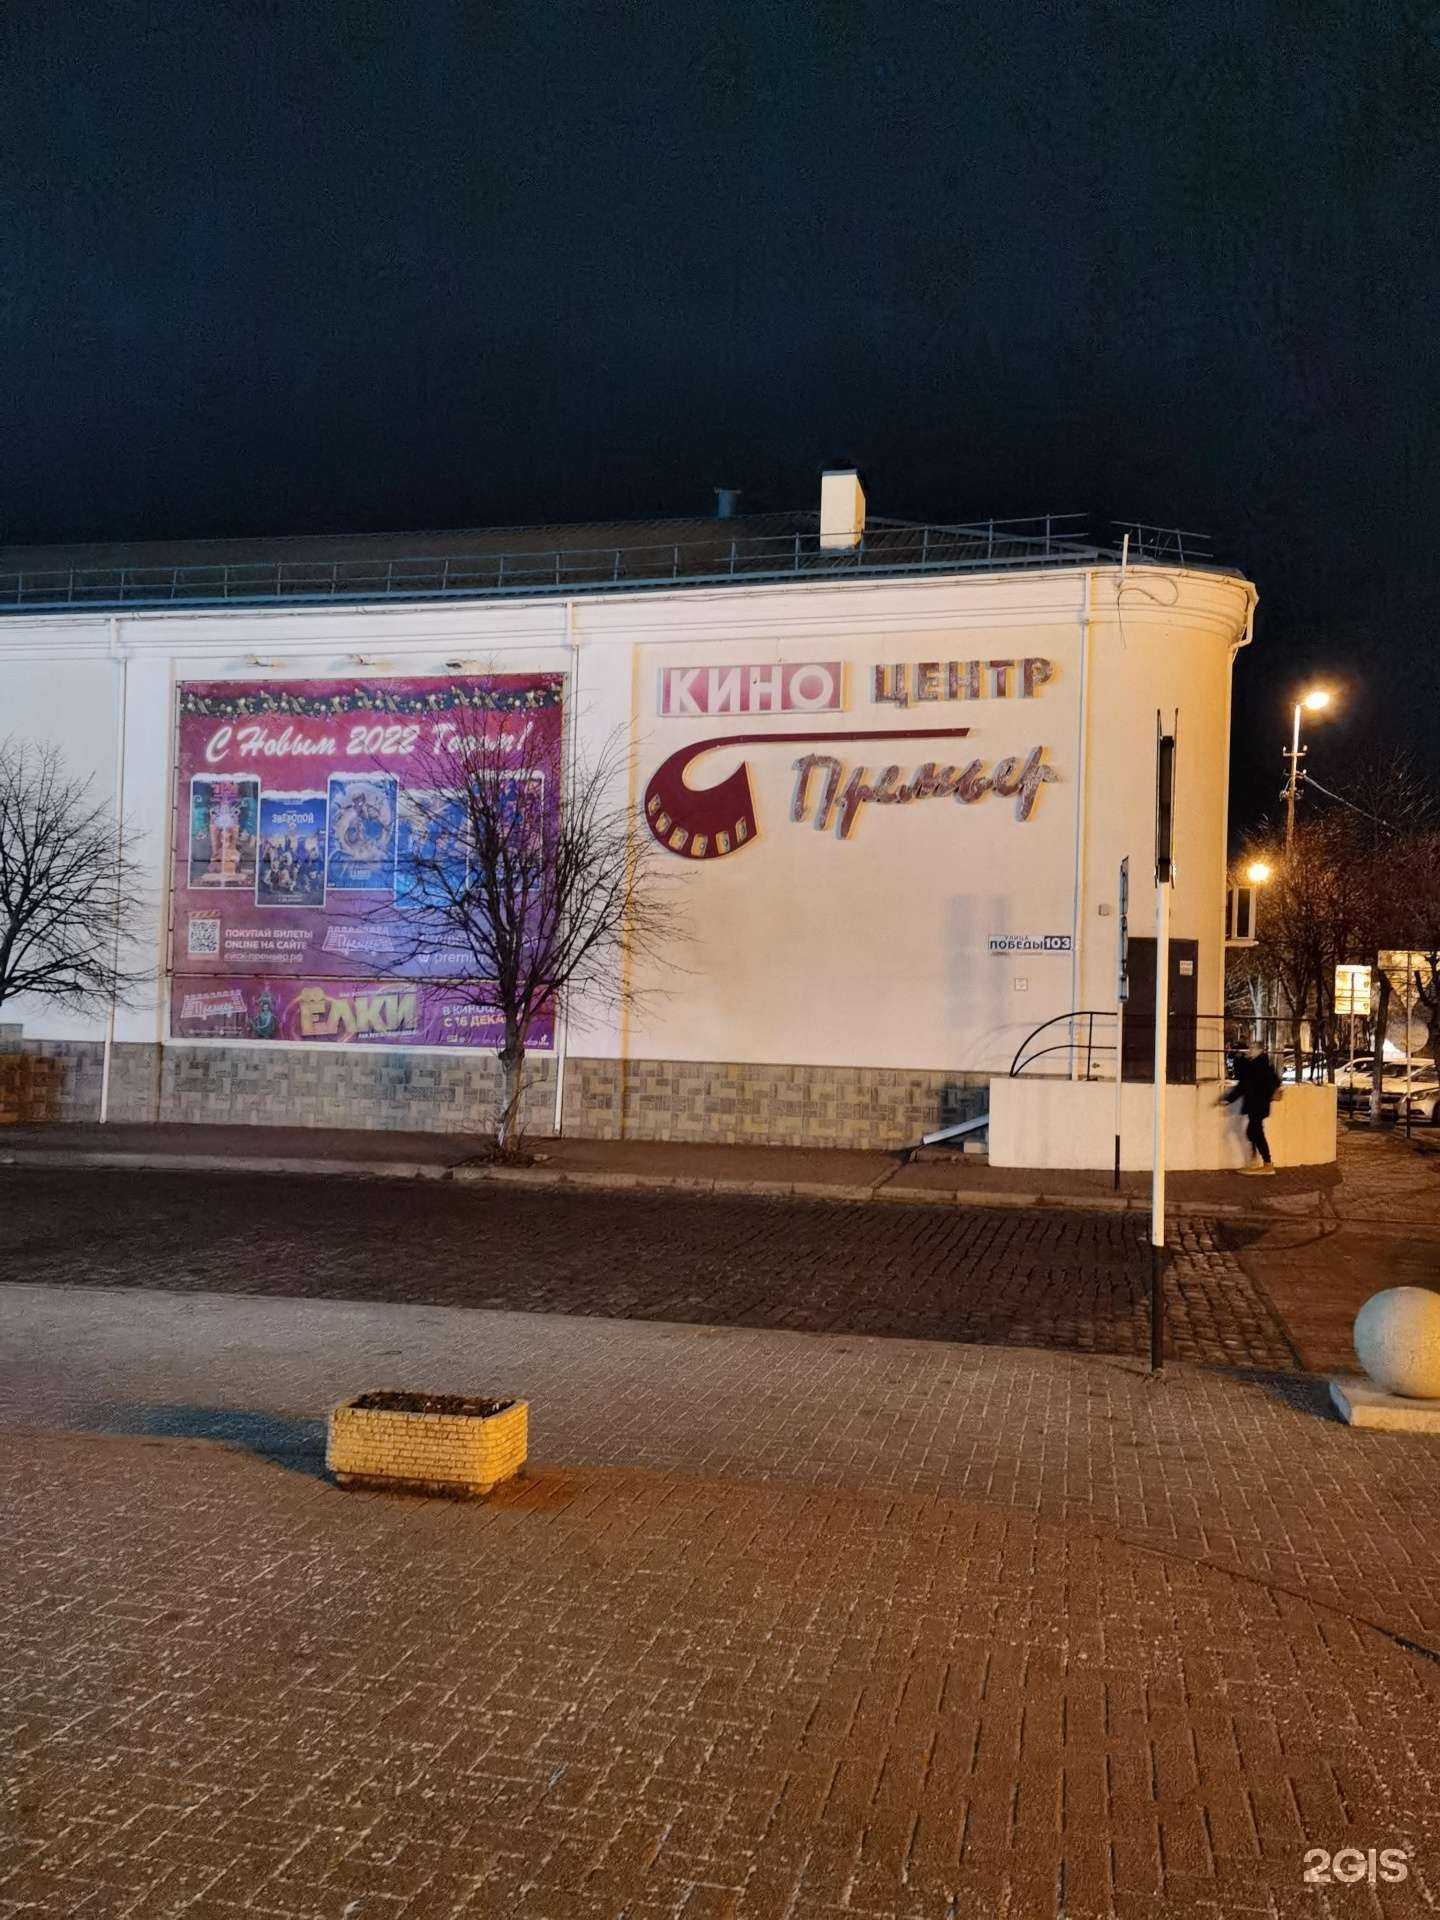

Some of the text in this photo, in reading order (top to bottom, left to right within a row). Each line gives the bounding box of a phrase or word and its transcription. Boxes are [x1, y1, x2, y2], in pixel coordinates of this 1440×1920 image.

[670, 657, 1054, 712] КИНО ЦЕНТР
[205, 726, 232, 763] С
[236, 725, 335, 757] Новым
[346, 724, 421, 755] 2022
[790, 745, 1061, 841] Премьер
[224, 928, 313, 939] ПОКУПАЙ БИЛЕТЫ
[224, 940, 259, 950] ONLINE
[260, 940, 274, 950] НА
[990, 937, 1071, 950] ПОБЕДЫ 103
